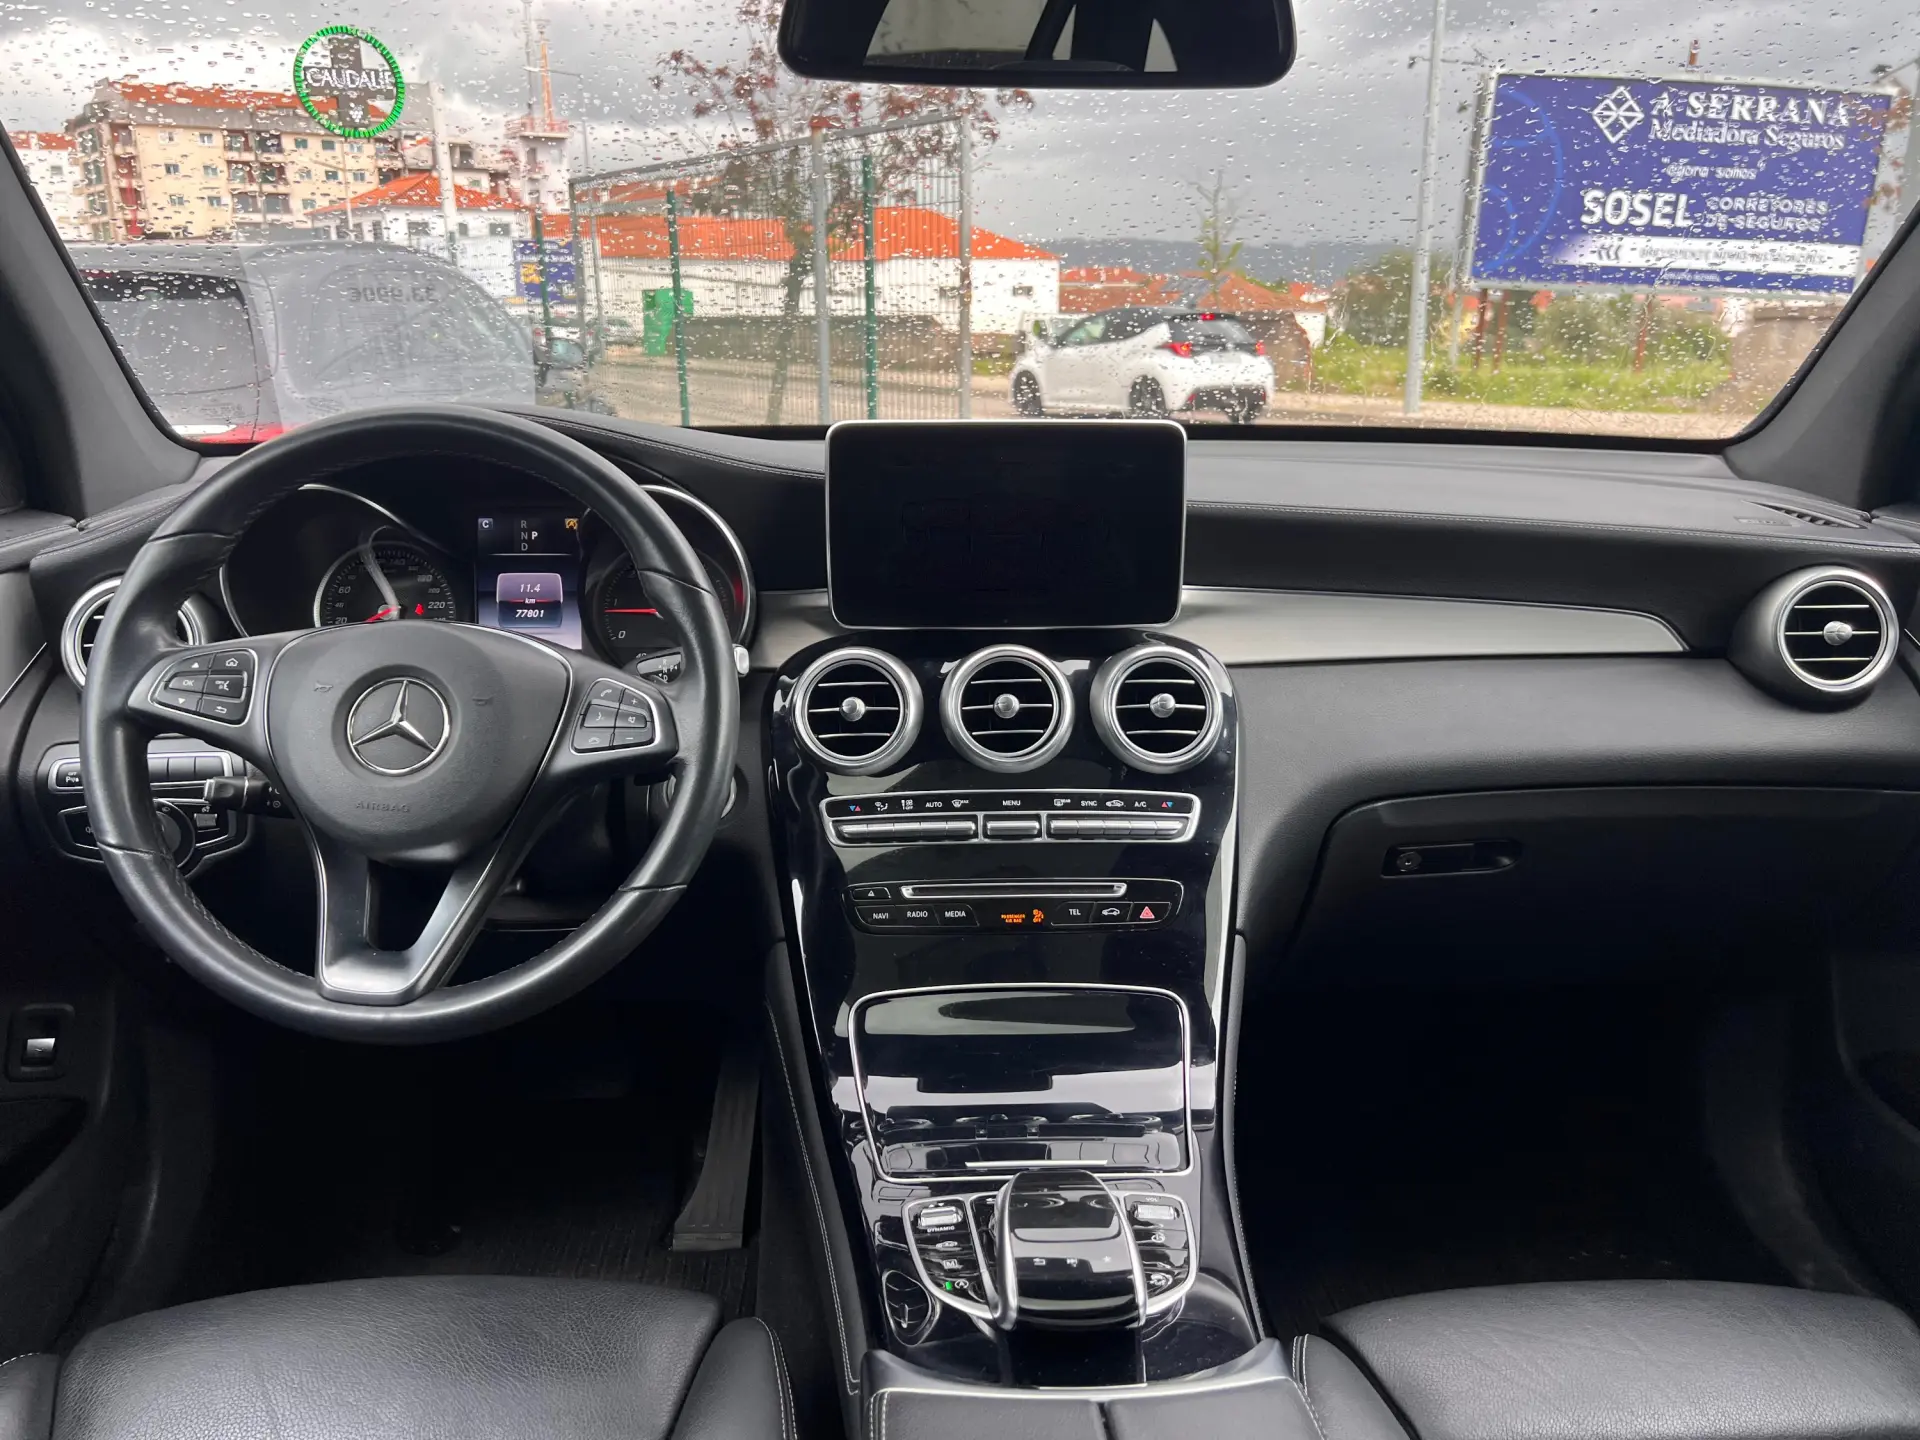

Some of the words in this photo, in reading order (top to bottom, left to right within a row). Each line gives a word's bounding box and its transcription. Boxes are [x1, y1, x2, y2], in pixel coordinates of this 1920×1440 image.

[1651, 91, 1674, 117] A
[1686, 91, 1850, 127] SERRANA
[1650, 118, 1760, 145] Mediadora
[1764, 125, 1846, 152] Seguros
[1580, 189, 1694, 227] SOSEL
[1706, 196, 1829, 216] CORRETORES
[1704, 213, 1728, 231] DE
[1734, 214, 1822, 232] SEGUROS
[520, 520, 527, 529] R
[520, 531, 528, 540] N
[531, 531, 539, 540] P
[521, 542, 529, 551] D
[338, 585, 351, 594] 60
[520, 583, 541, 593] 11.4
[428, 601, 446, 609] 220
[515, 609, 545, 618] 77801
[335, 616, 347, 625] 20
[182, 679, 195, 687] OK
[356, 801, 411, 813] AIRBAG
[907, 910, 928, 918] RADIO
[944, 910, 966, 918] MEDIA
[1068, 908, 1081, 916] TEL
